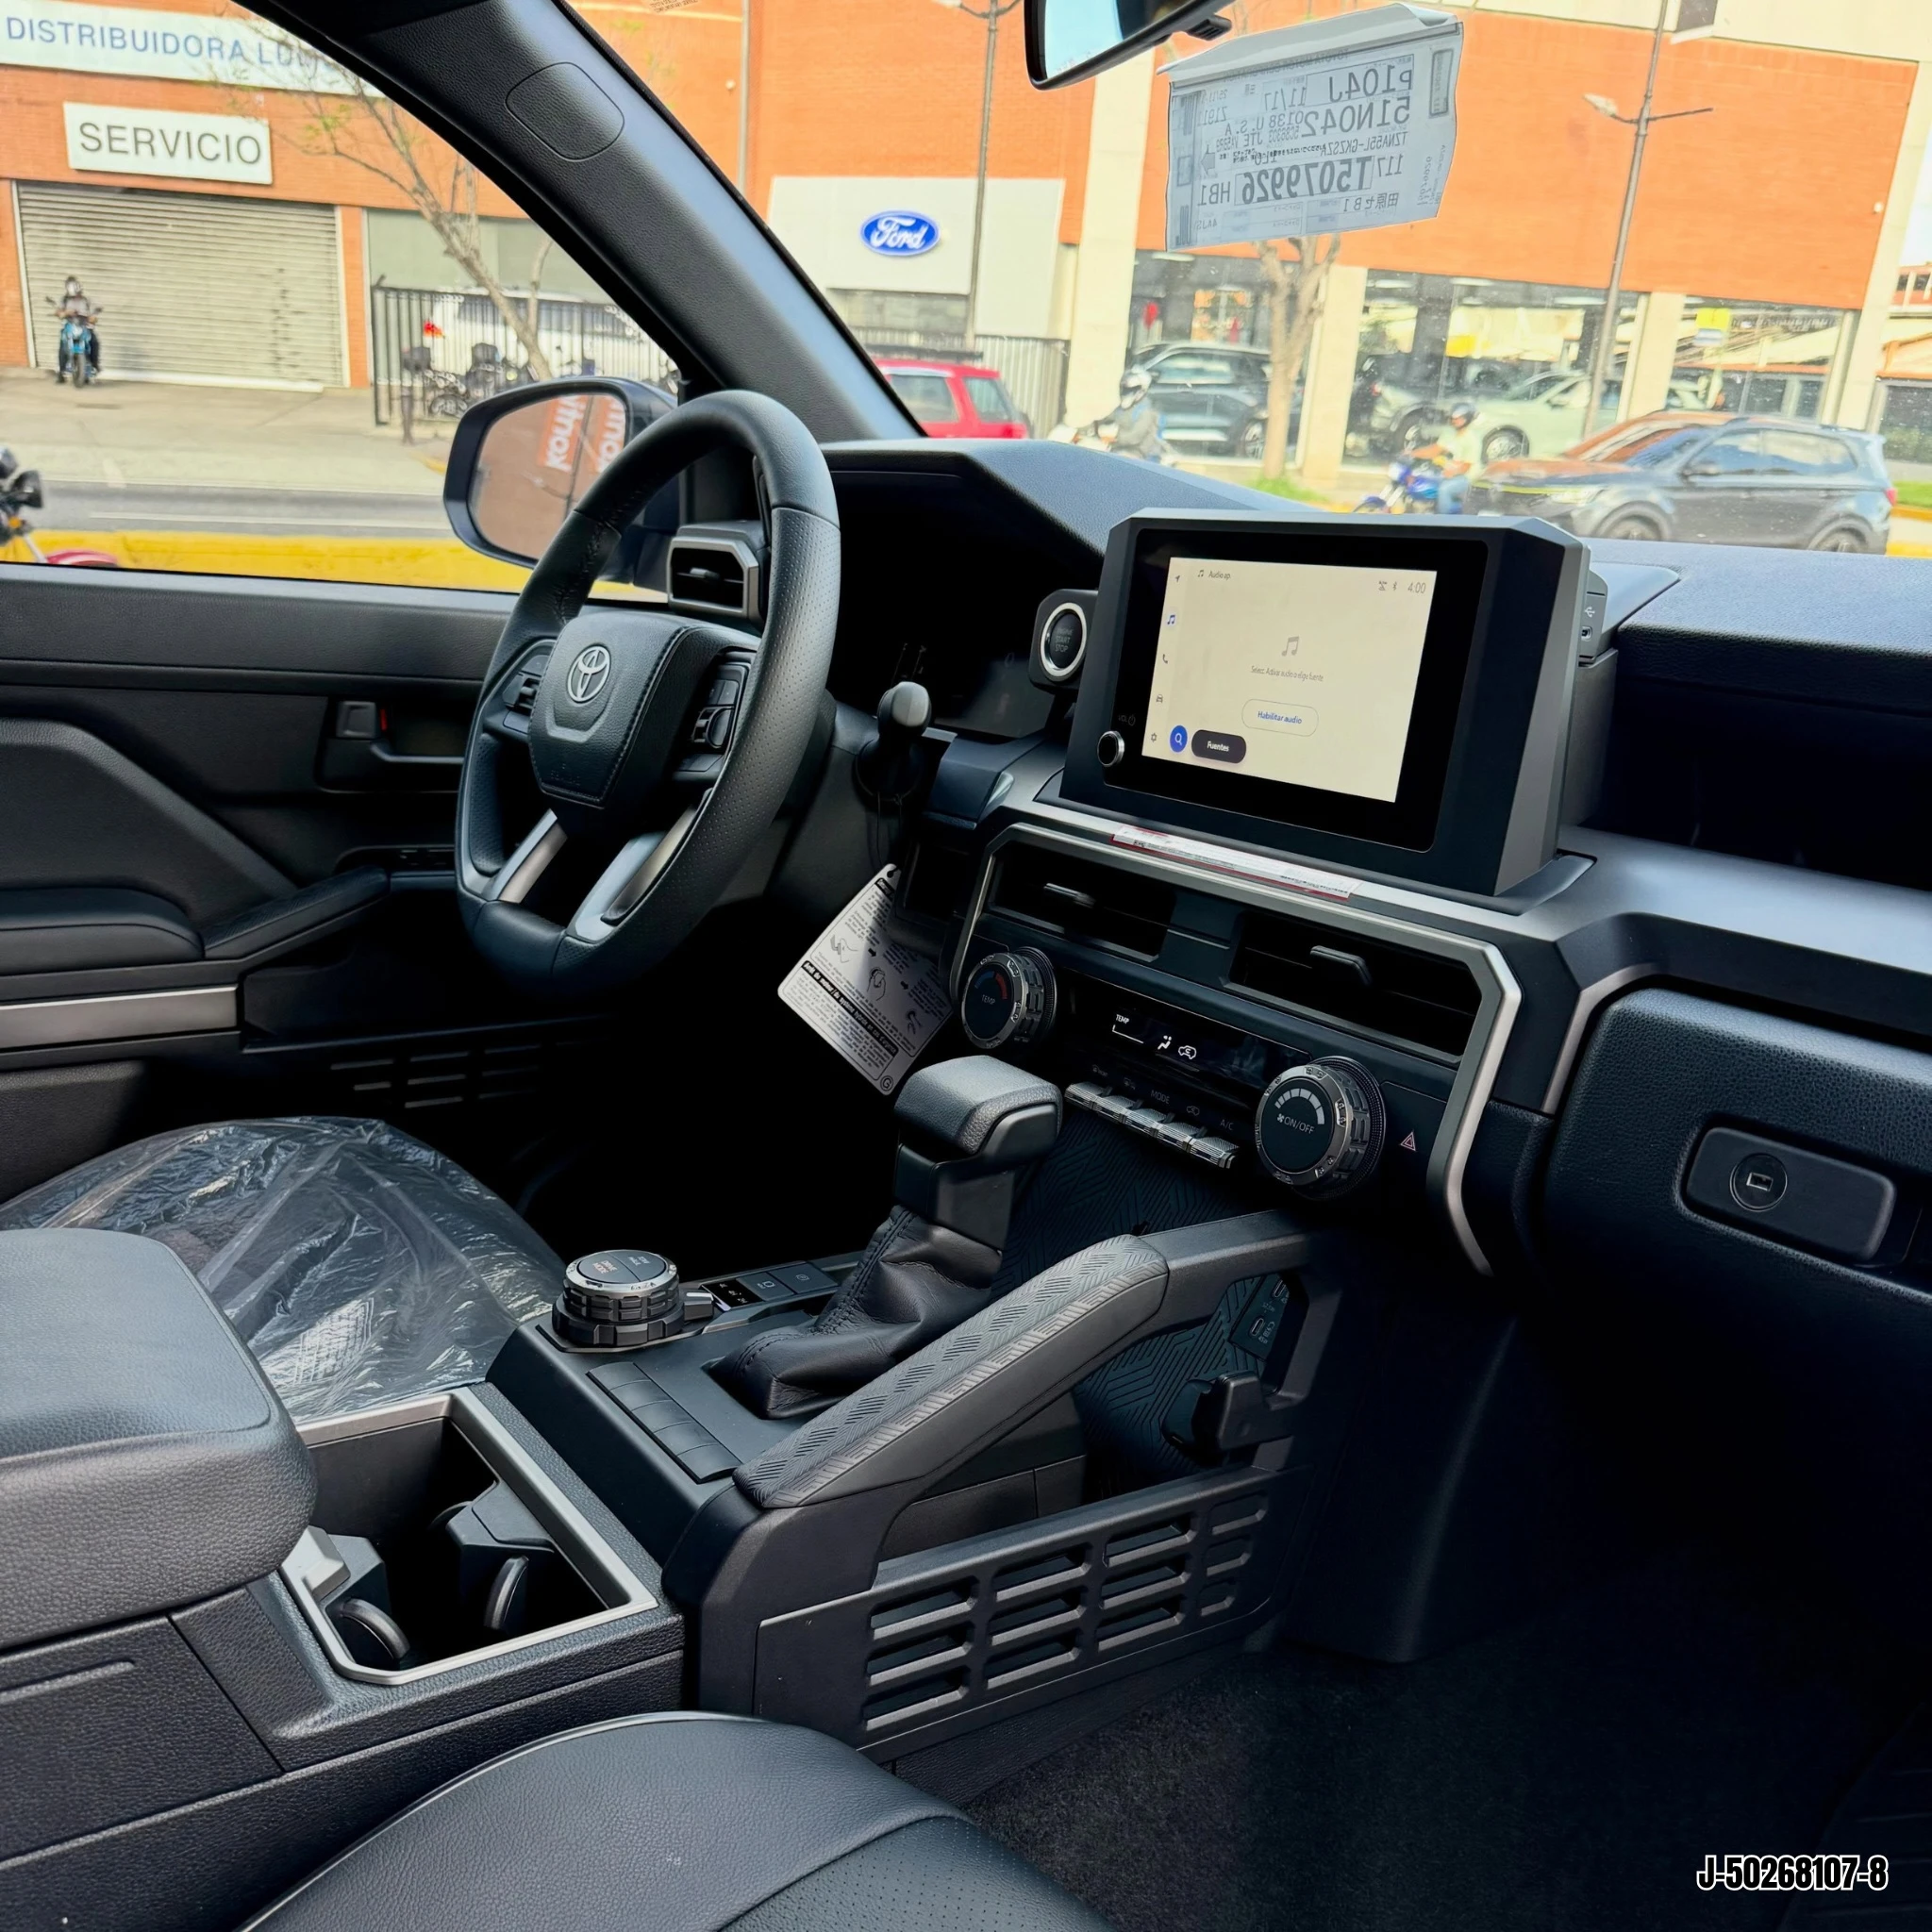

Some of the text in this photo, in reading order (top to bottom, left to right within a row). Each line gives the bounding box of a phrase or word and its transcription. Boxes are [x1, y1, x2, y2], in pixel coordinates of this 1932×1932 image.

[7, 17, 245, 61] DISTRIBUIDORA
[79, 123, 262, 165] SERVICIO
[870, 216, 929, 251] Ford
[1407, 581, 1426, 594] 4:00
[1056, 636, 1072, 644] START
[1055, 644, 1069, 653] STOP
[1257, 710, 1302, 724] Habilitar audio
[1207, 741, 1229, 753] Fuentes
[981, 994, 996, 1006] TEMP
[1115, 1013, 1130, 1024] TEMP
[1150, 1090, 1171, 1105] MODE
[1219, 1119, 1234, 1131] A/C
[1284, 1117, 1315, 1135] ON/OFF
